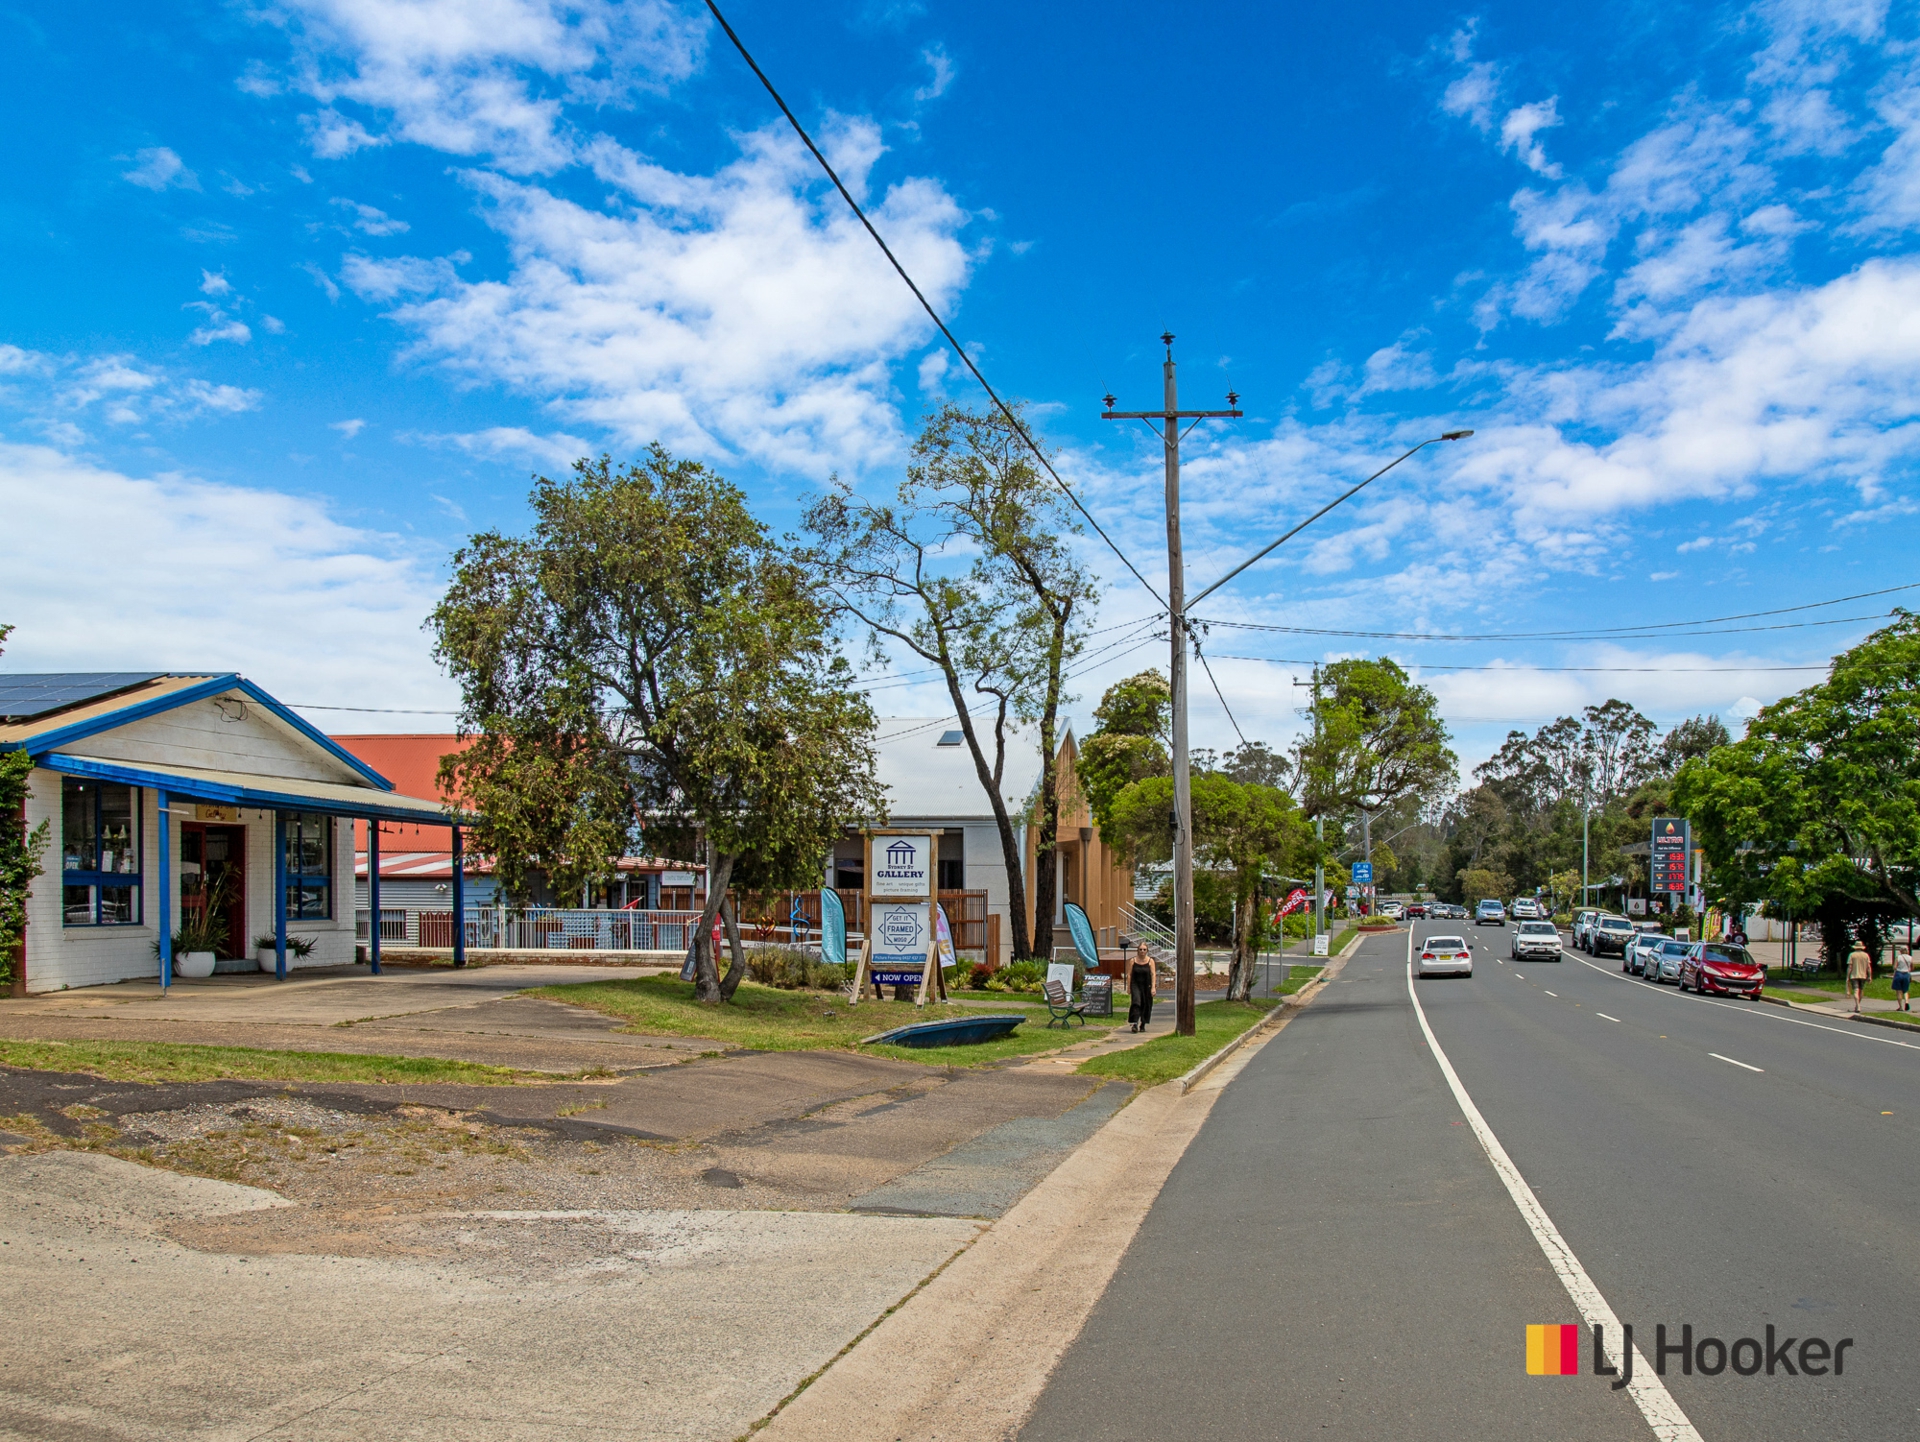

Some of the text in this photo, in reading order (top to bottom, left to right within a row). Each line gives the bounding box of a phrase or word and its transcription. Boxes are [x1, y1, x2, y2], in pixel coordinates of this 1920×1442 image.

[1656, 836, 1684, 844] ULTRA
[877, 870, 924, 878] GALLERY
[1282, 893, 1305, 912] OPEN
[887, 925, 914, 933] FRAMED
[903, 974, 924, 982] OPEN
